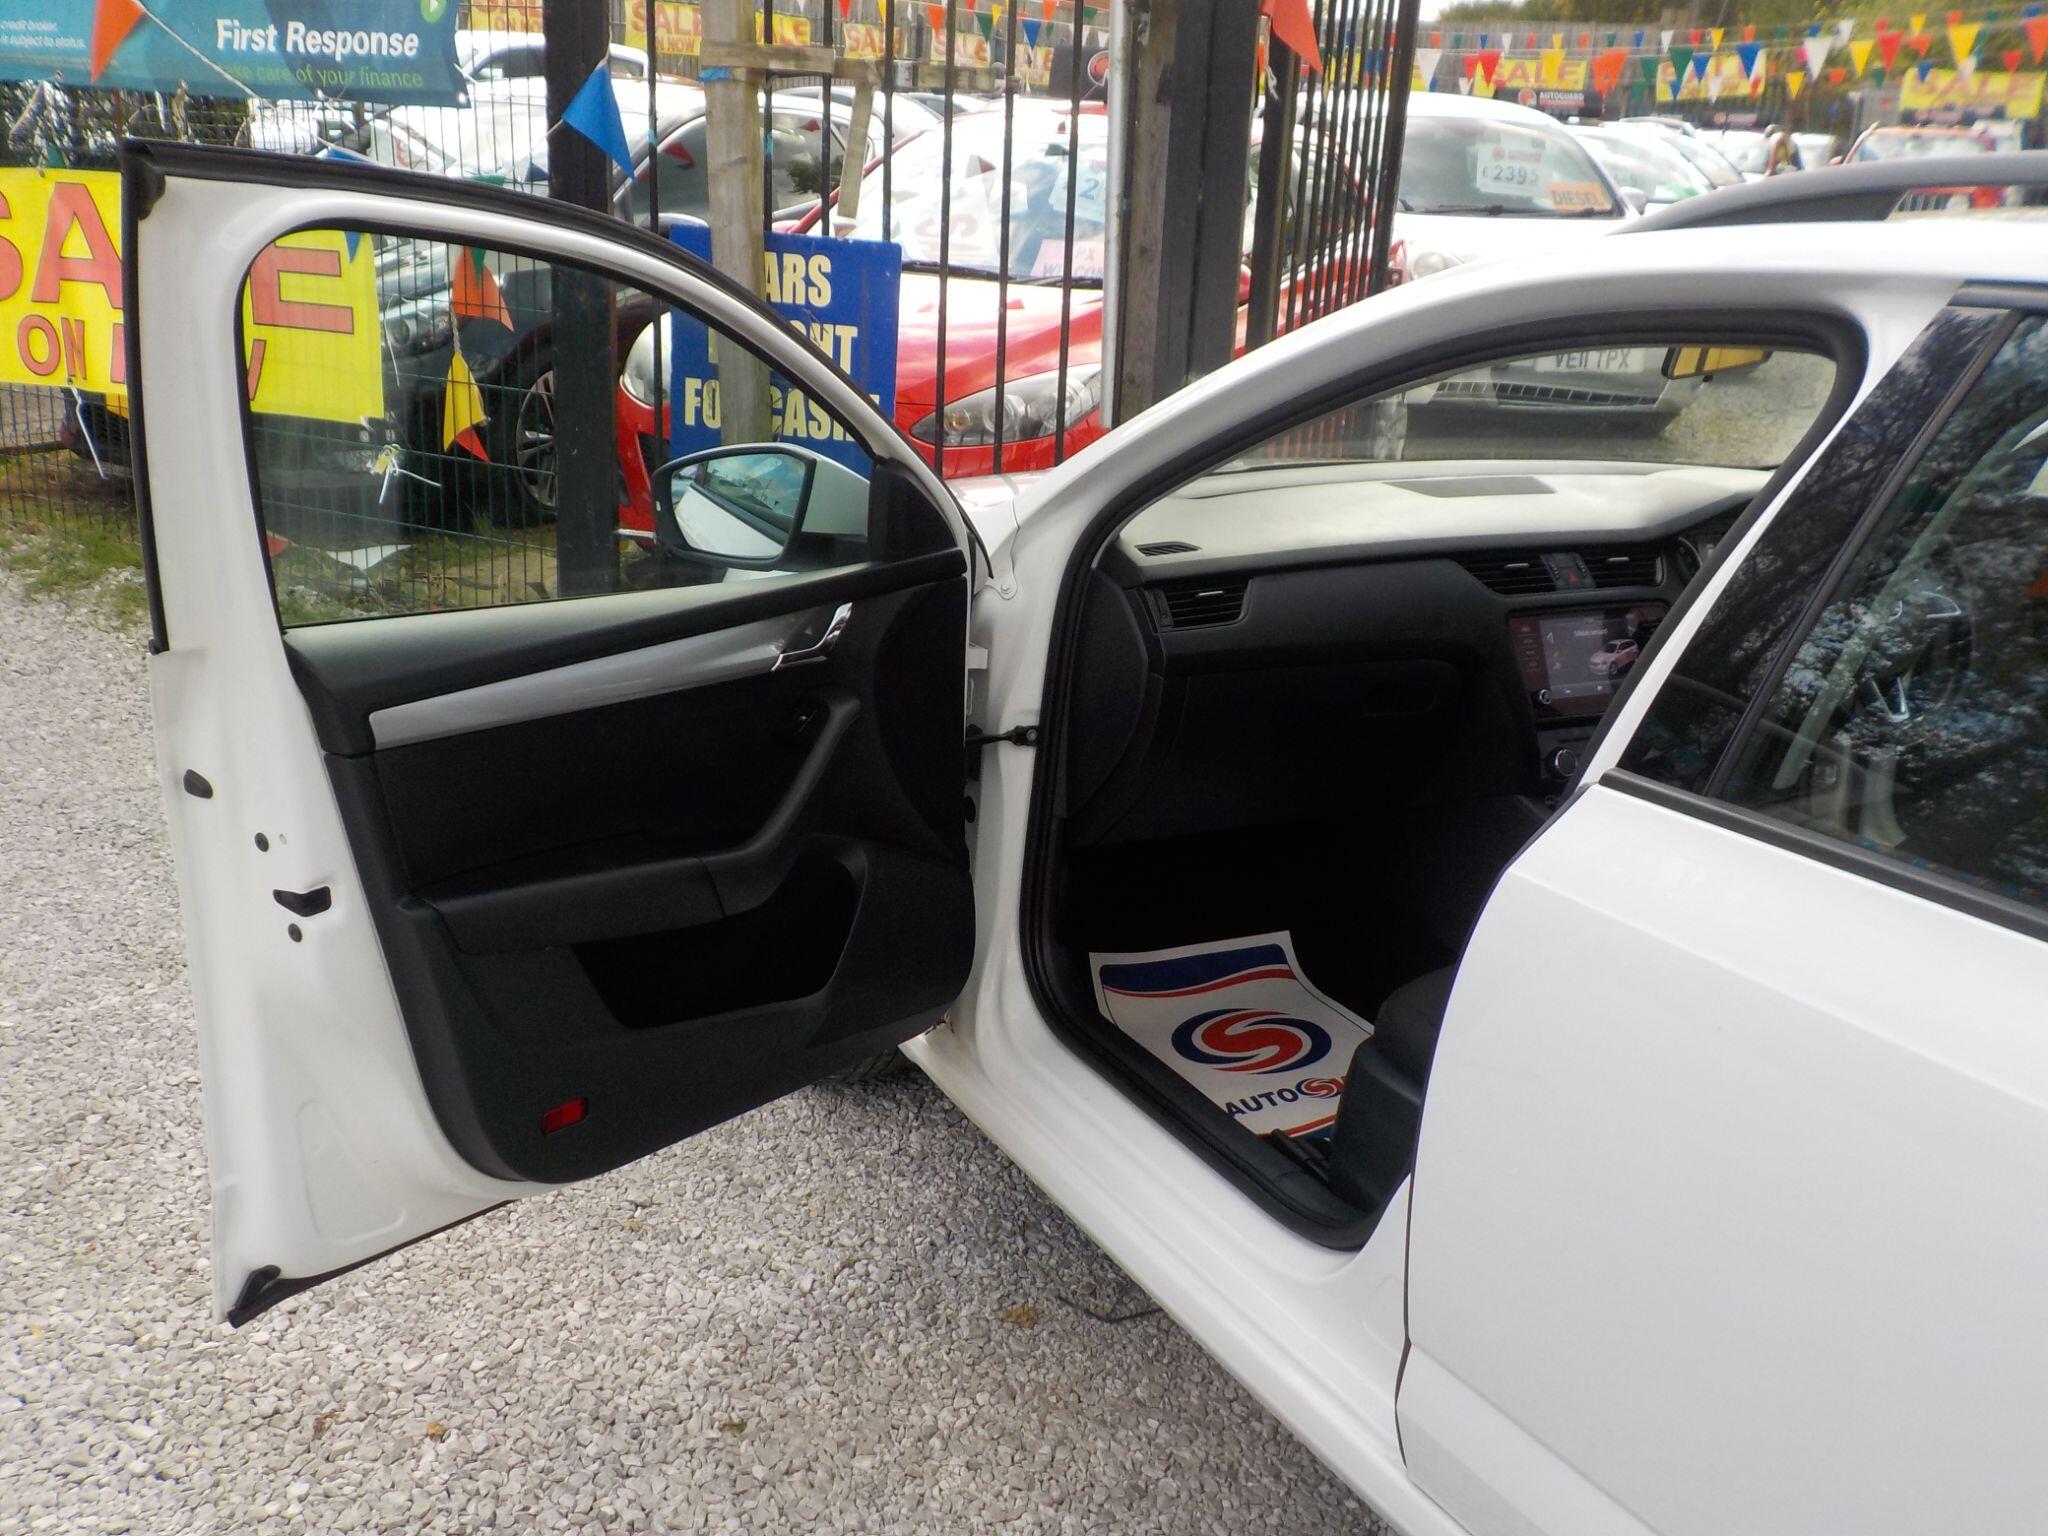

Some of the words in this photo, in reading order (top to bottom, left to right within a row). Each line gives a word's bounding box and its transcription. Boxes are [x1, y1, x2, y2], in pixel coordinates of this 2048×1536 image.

[216, 19, 278, 50] First
[286, 21, 420, 62] Response
[668, 37, 695, 53] NOW
[256, 66, 291, 82] care
[296, 64, 314, 83] of
[317, 69, 355, 87] your
[361, 66, 424, 89] finance
[1553, 189, 1606, 207] DIESEL
[764, 251, 832, 308] ARS
[17, 313, 87, 381] ON
[684, 376, 722, 430] FO
